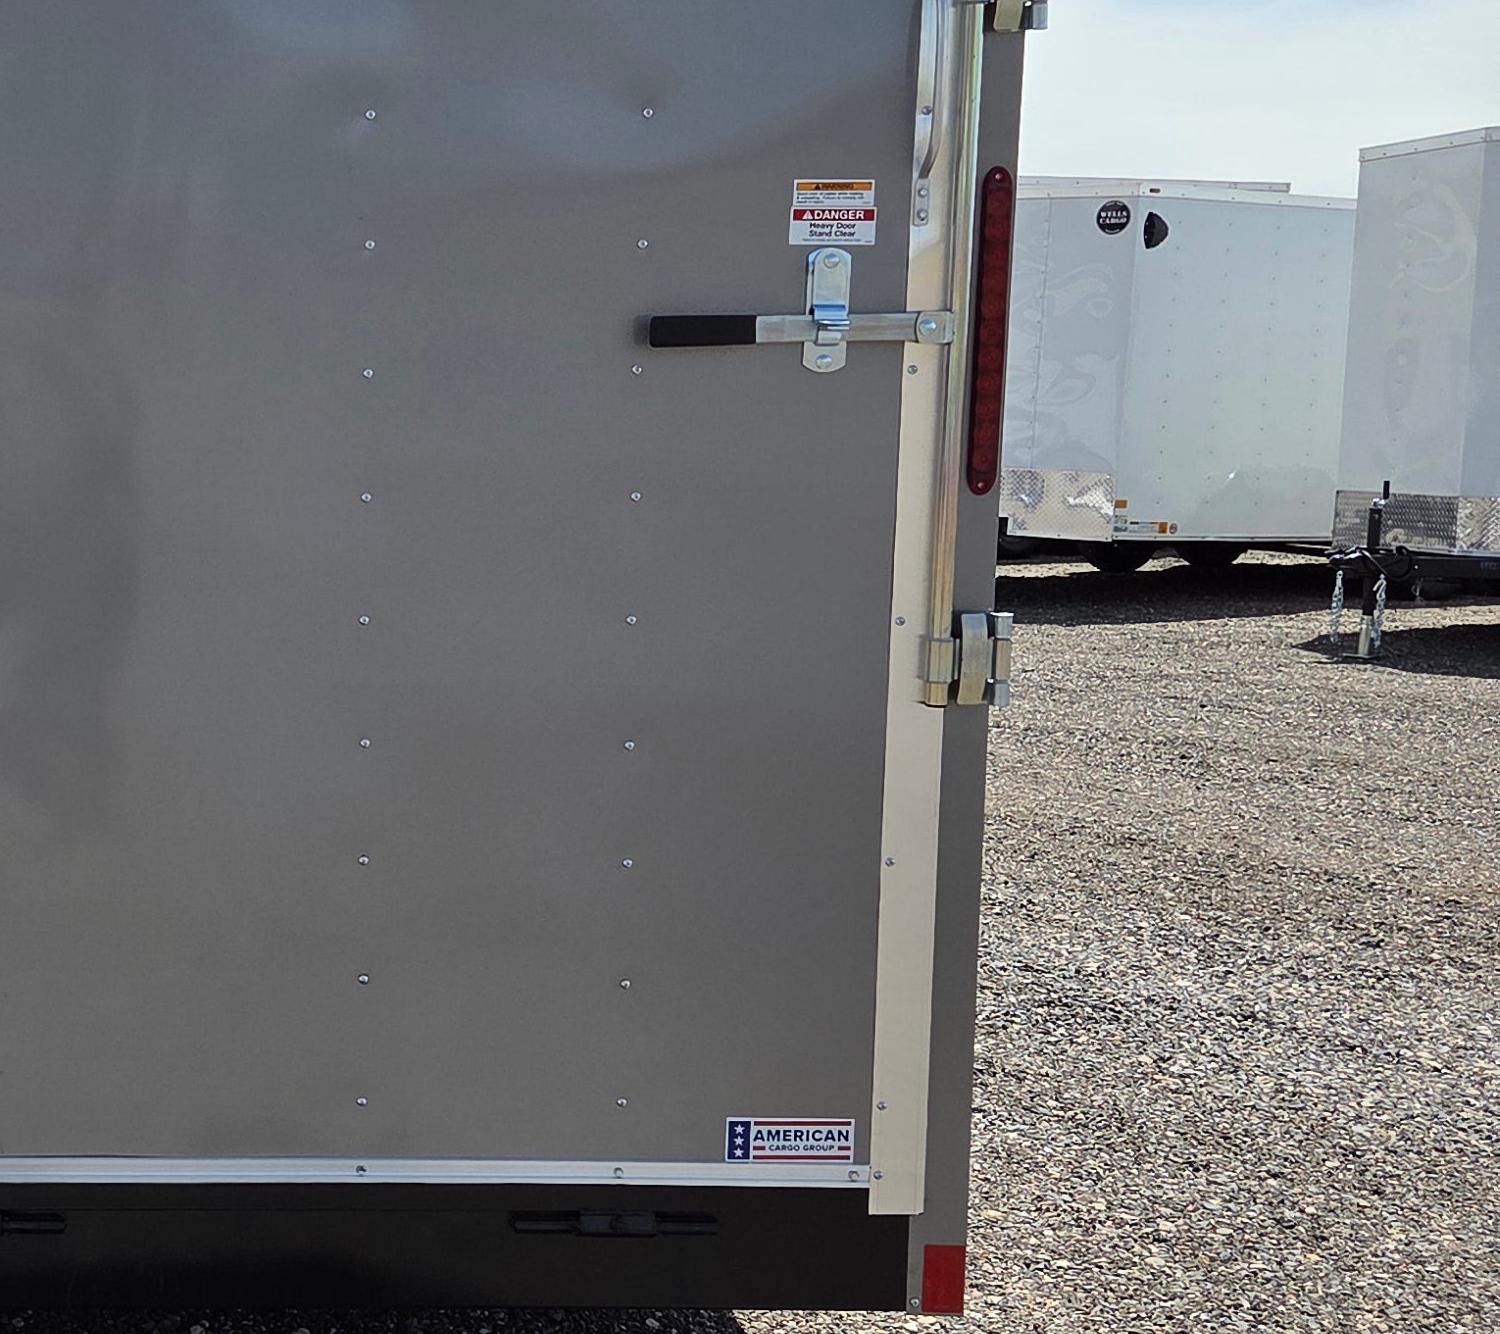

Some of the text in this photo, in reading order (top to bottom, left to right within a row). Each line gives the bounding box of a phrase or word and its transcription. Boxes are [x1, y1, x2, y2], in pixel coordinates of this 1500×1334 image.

[814, 210, 864, 220] DANGER
[809, 222, 856, 231] Heavy Door
[753, 1129, 850, 1142] AMERICAN
[768, 1144, 835, 1152] CARGO GROUP
